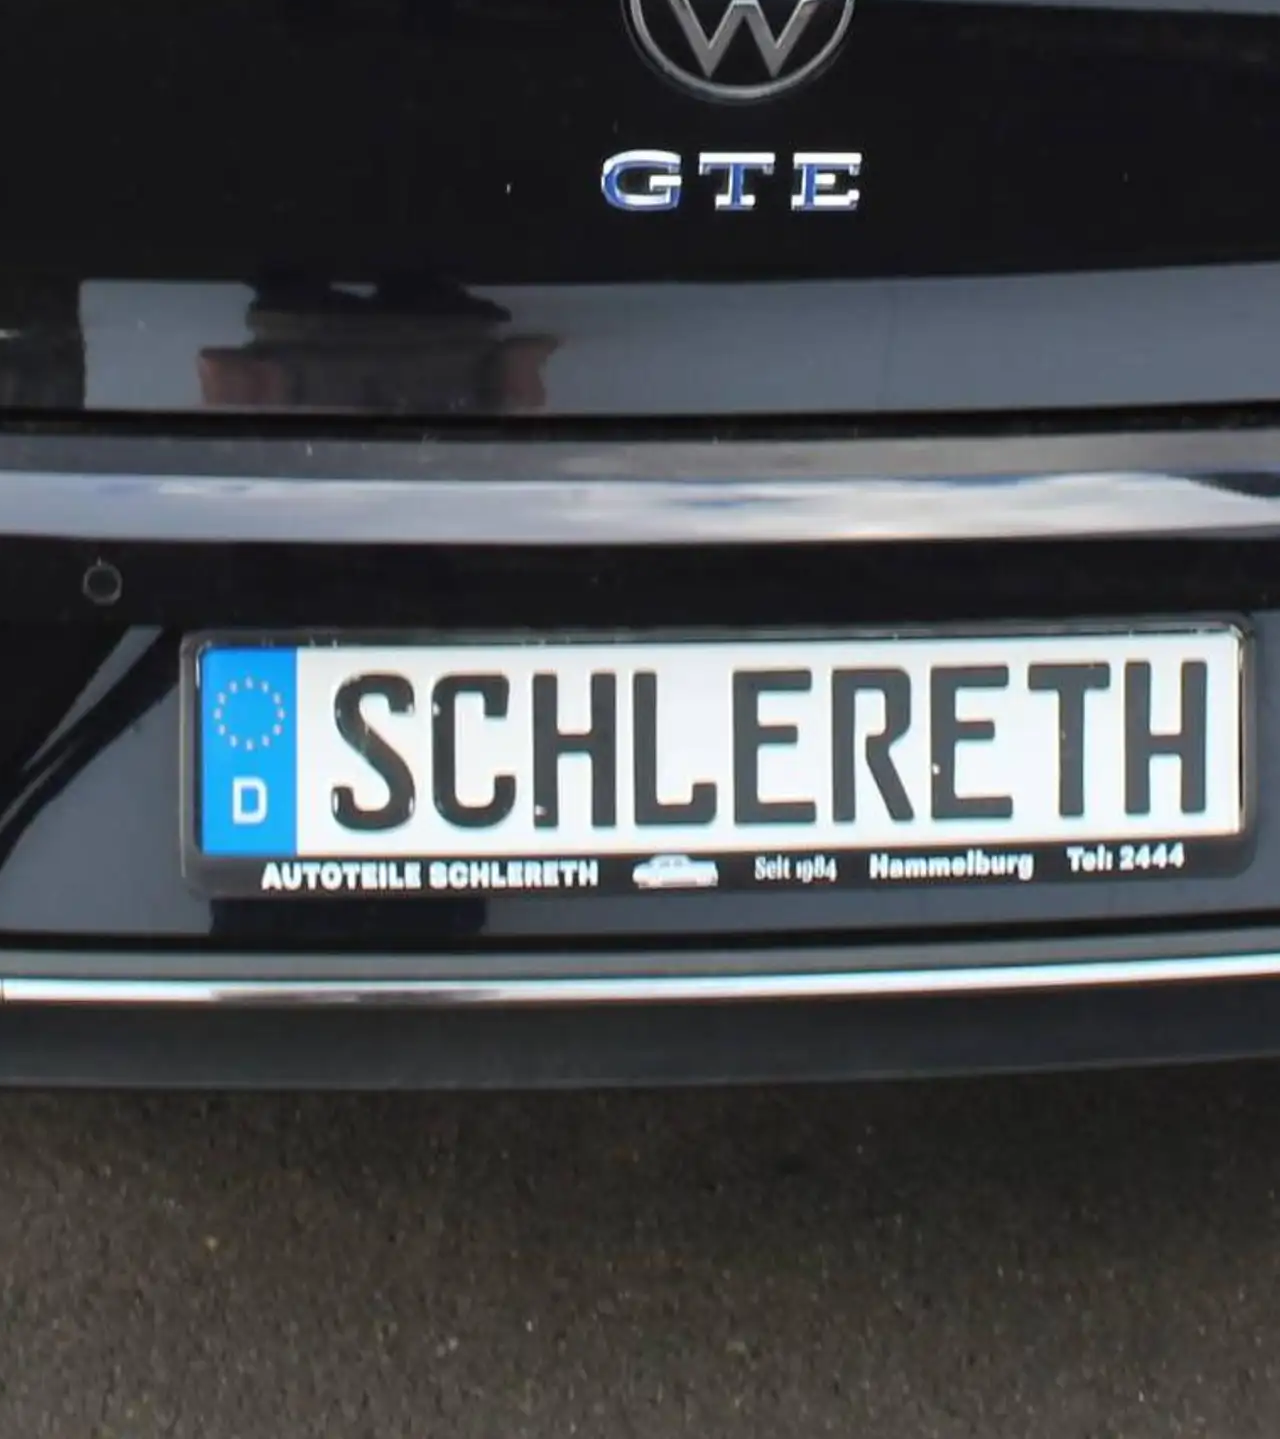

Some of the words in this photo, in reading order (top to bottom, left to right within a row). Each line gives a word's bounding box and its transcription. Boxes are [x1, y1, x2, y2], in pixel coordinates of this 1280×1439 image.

[601, 149, 862, 211] GTE
[330, 660, 1208, 831] SCHLERETH
[232, 775, 267, 824] D
[261, 861, 421, 890] AUTOTEILE
[429, 858, 600, 888] SCHLERETH
[754, 854, 791, 880] Seit
[796, 854, 838, 883] 1984
[869, 848, 1035, 881] Hammelburg
[1119, 841, 1185, 871] 2444
